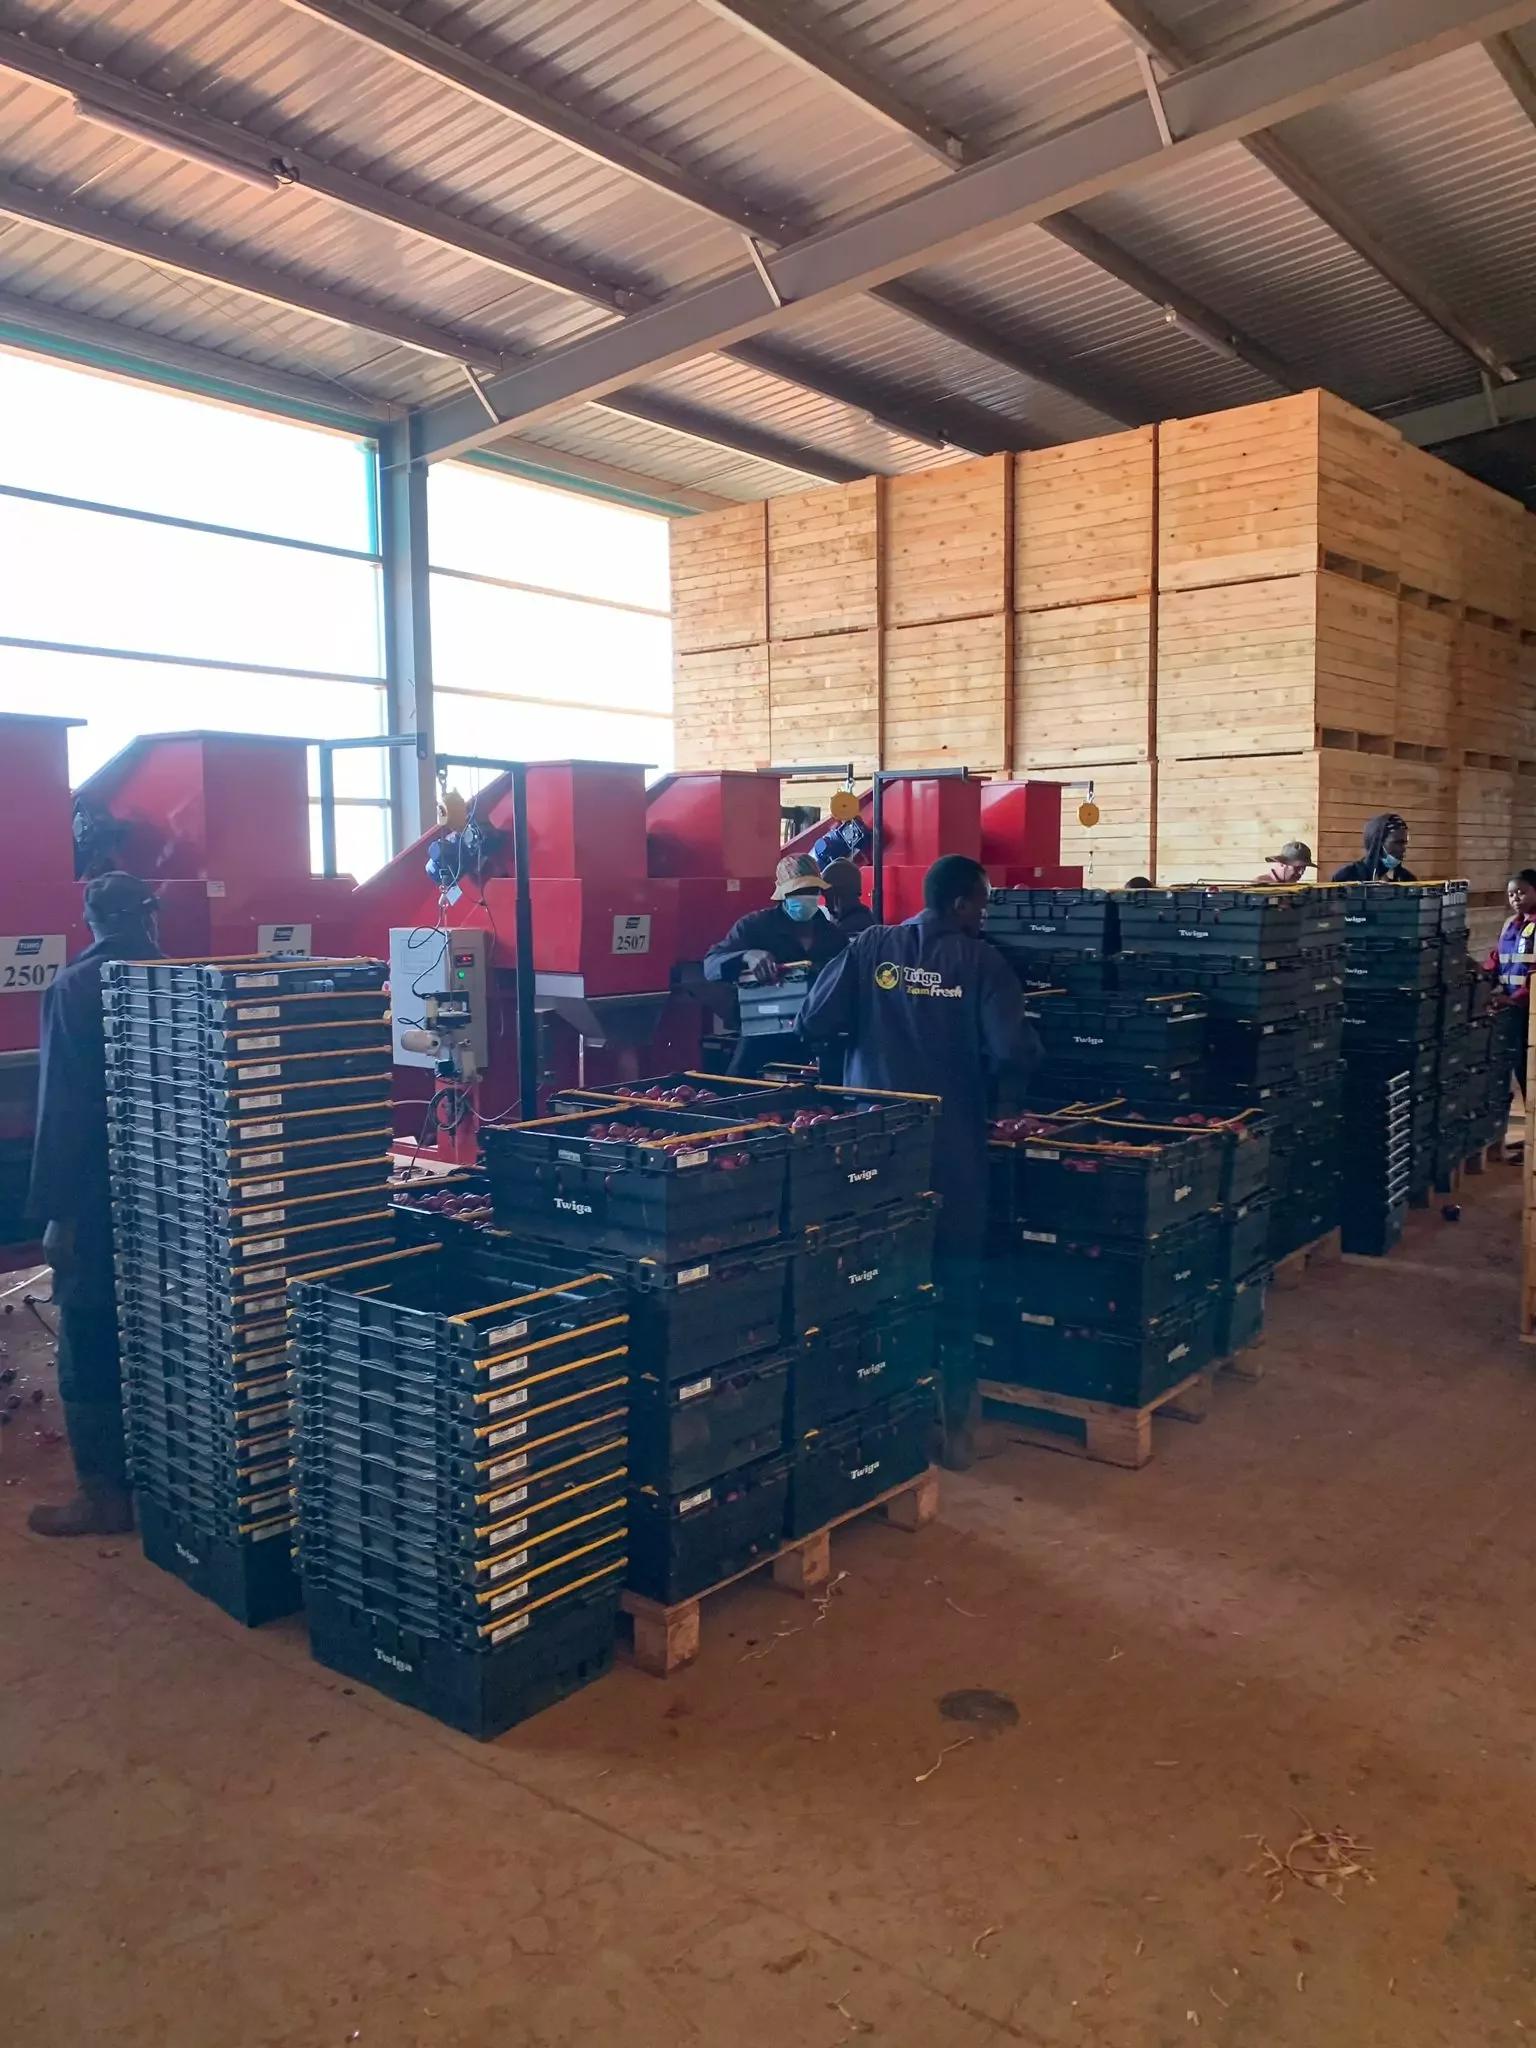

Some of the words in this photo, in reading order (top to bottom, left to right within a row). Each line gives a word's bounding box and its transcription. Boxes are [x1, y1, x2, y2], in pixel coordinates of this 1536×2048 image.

[1029, 924, 1056, 932] Twiga
[1179, 929, 1208, 938] Twiga
[616, 935, 646, 950] 2507
[4, 964, 59, 988] 2507
[1073, 1036, 1103, 1045] Twiga
[848, 1168, 878, 1183] Twiga
[554, 1198, 592, 1214] Twiga
[848, 1268, 879, 1284] Twiga
[857, 1361, 886, 1378] Twiga
[850, 1460, 880, 1480] Twiga
[374, 1648, 413, 1672] Twiga
